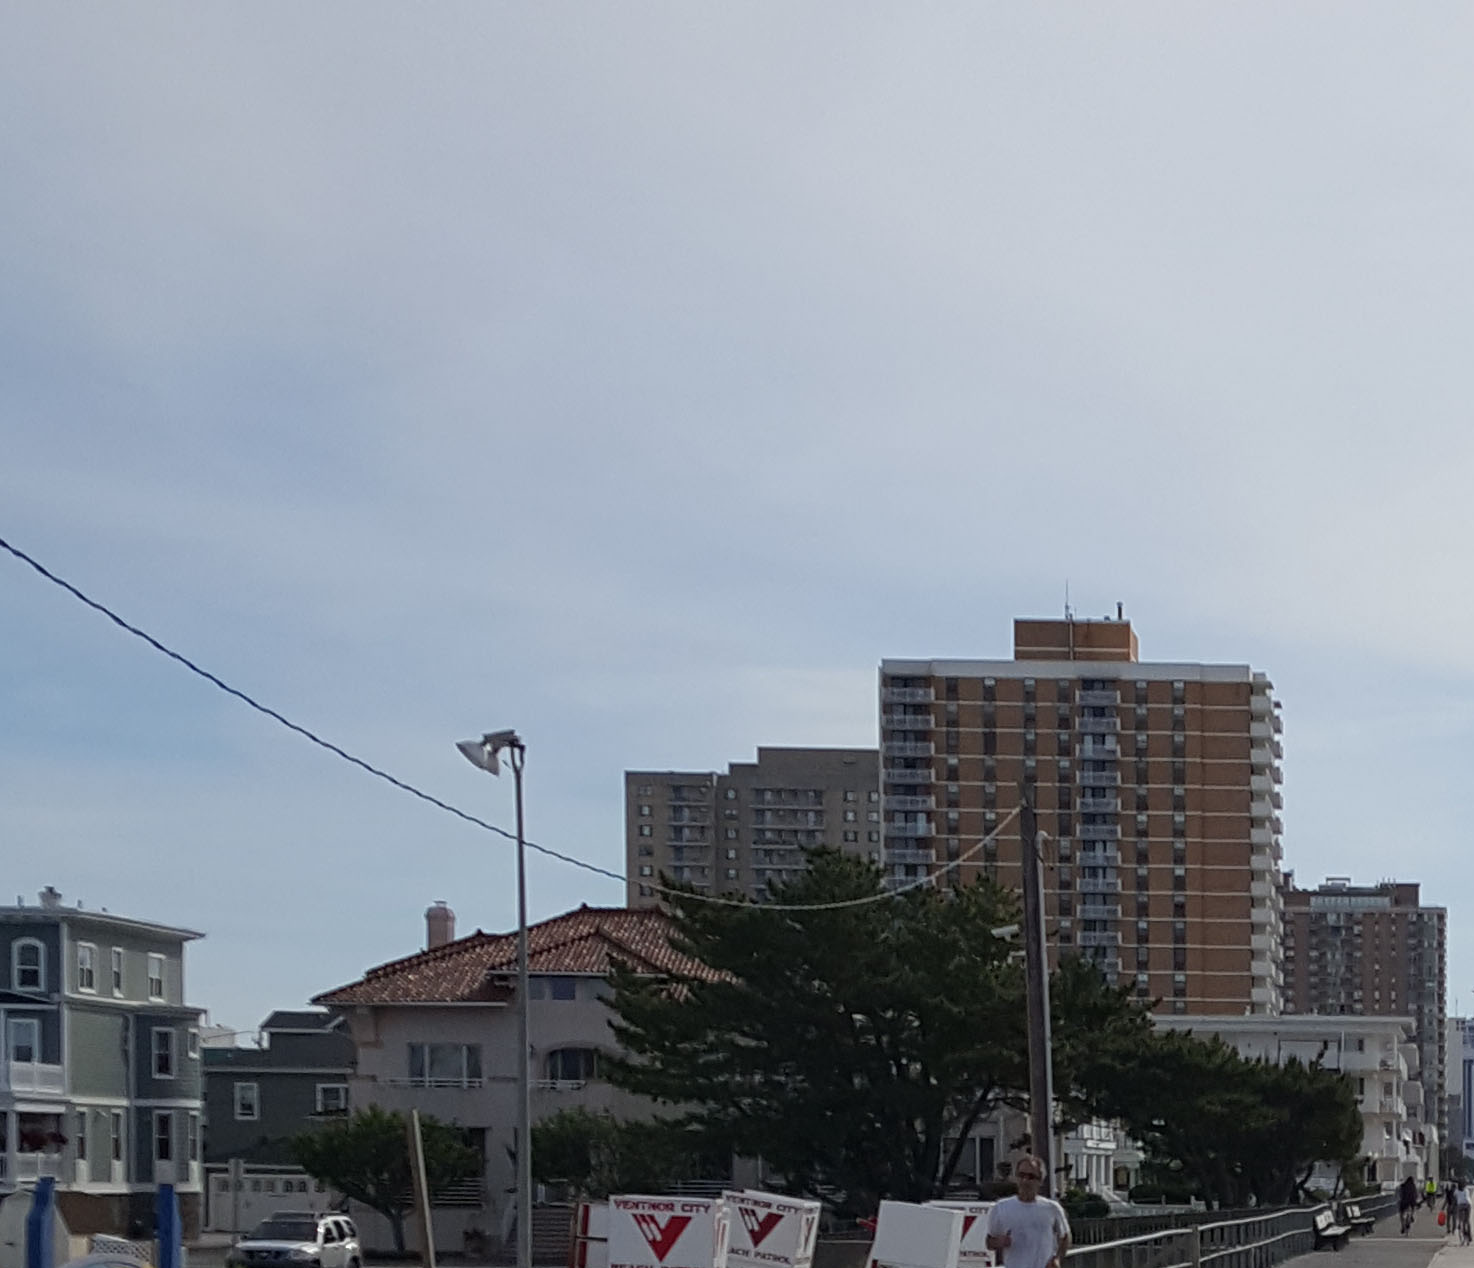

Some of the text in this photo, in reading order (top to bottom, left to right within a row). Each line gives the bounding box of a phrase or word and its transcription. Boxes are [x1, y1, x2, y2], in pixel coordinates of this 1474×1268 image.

[614, 1200, 711, 1213] VENTNOR CITY
[776, 1204, 800, 1214] CITY
[728, 1247, 791, 1265] ACH PATROL
